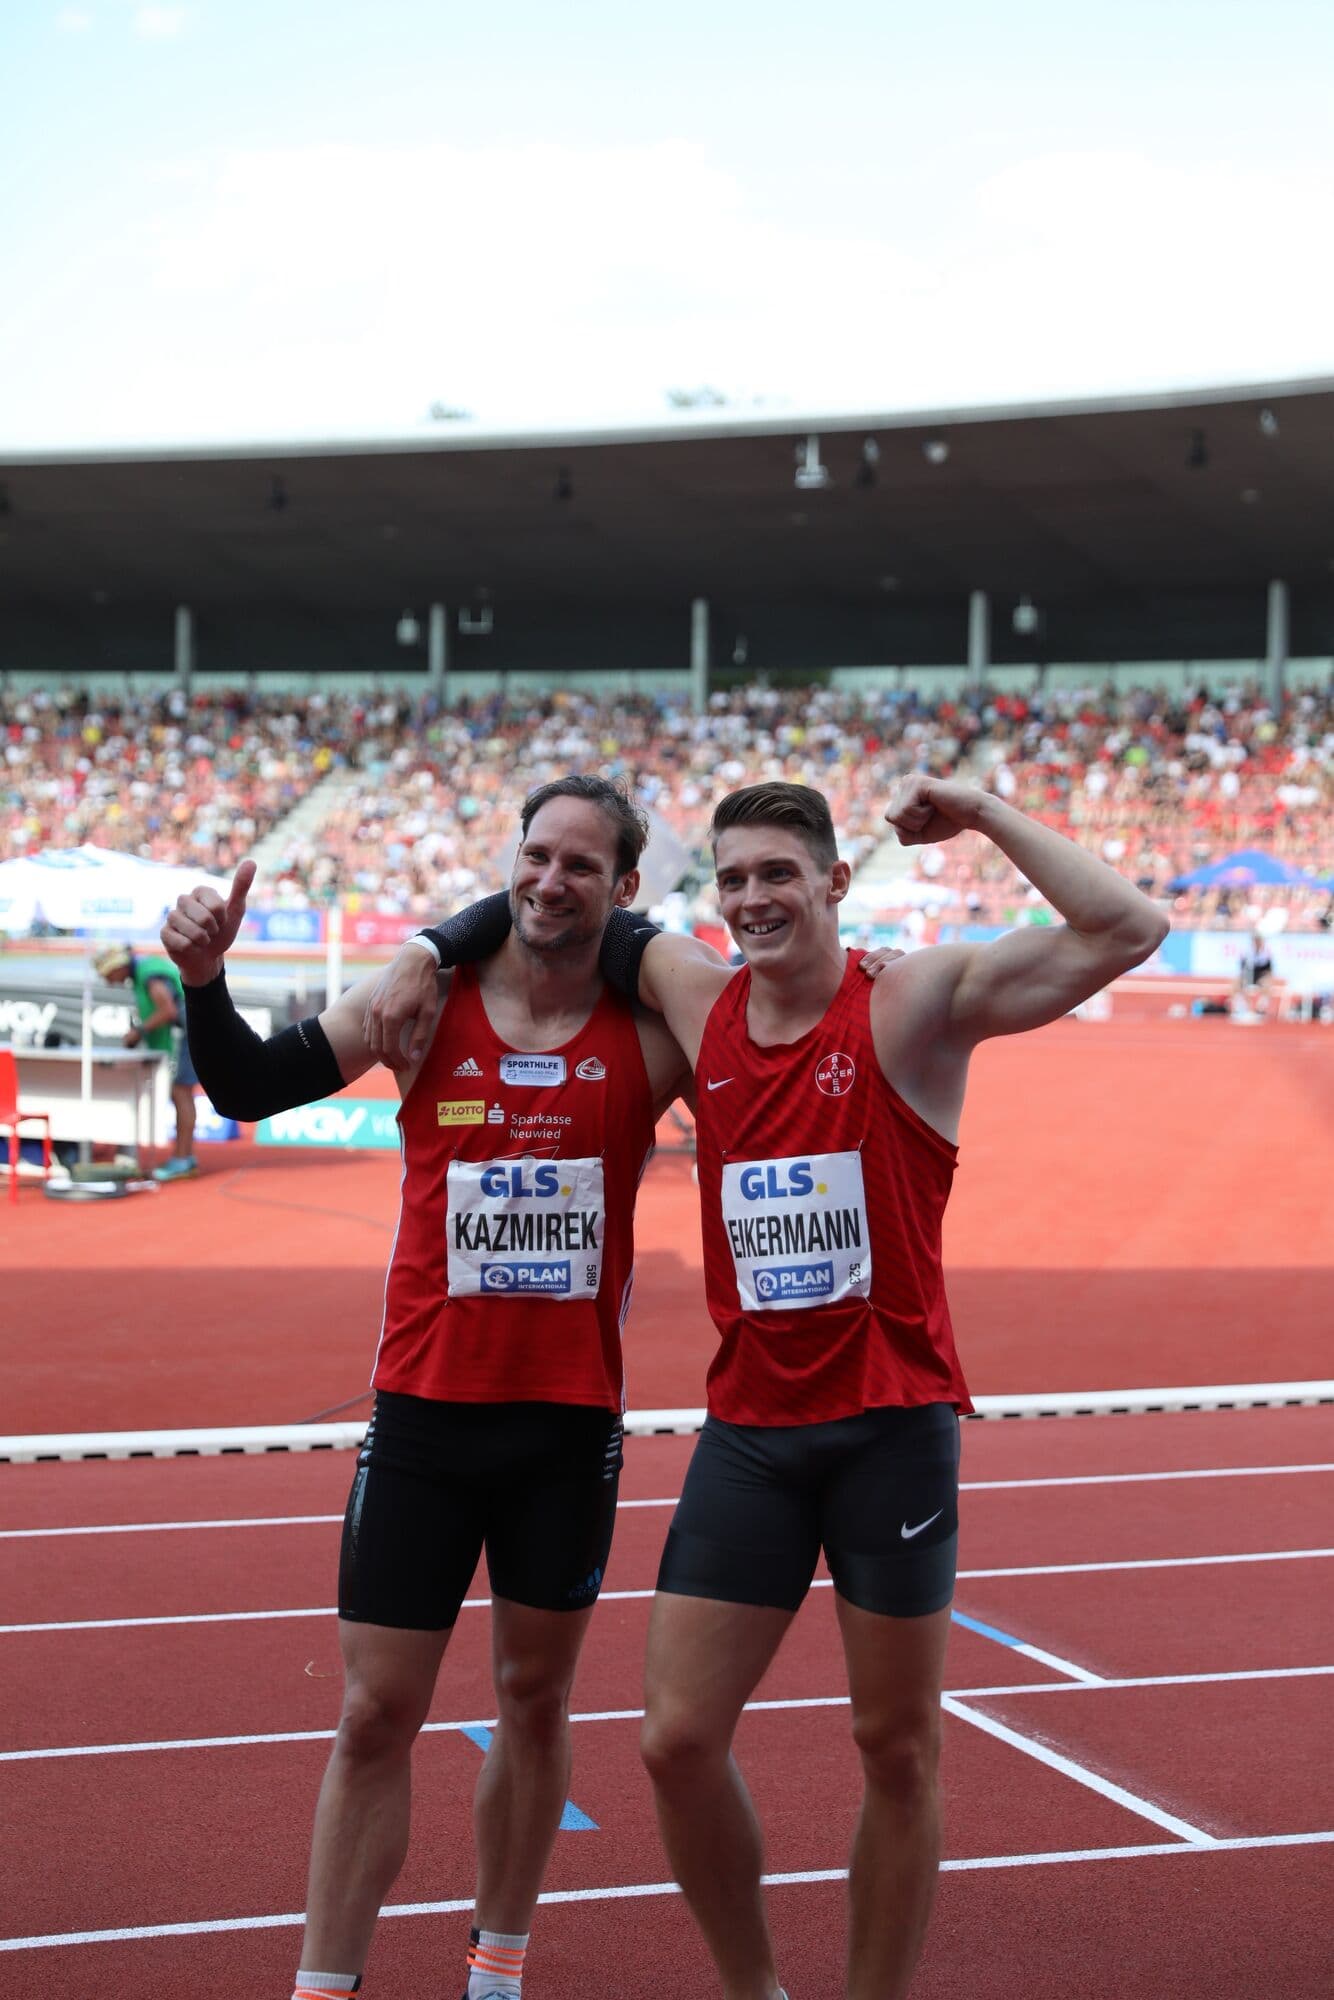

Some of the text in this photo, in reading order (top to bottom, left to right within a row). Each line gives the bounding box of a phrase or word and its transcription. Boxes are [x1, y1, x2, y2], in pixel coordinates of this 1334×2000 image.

[453, 1068, 484, 1077] adidas
[507, 1060, 559, 1070] SPORTHILFE
[818, 1068, 853, 1081] BAYER
[831, 1055, 841, 1094] BAYER
[452, 1105, 484, 1116] LOTTO
[511, 1113, 572, 1126] Sparkasse
[510, 1128, 561, 1140] Neuwied
[455, 1211, 598, 1252] KAZMIREK
[728, 1207, 862, 1259] EIKERMANN
[518, 1266, 566, 1283] PLAN
[587, 1264, 597, 1287] 589
[780, 1268, 830, 1288] PLAN
[849, 1263, 861, 1285] 523
[781, 1286, 830, 1296] INTERNATIONAL
